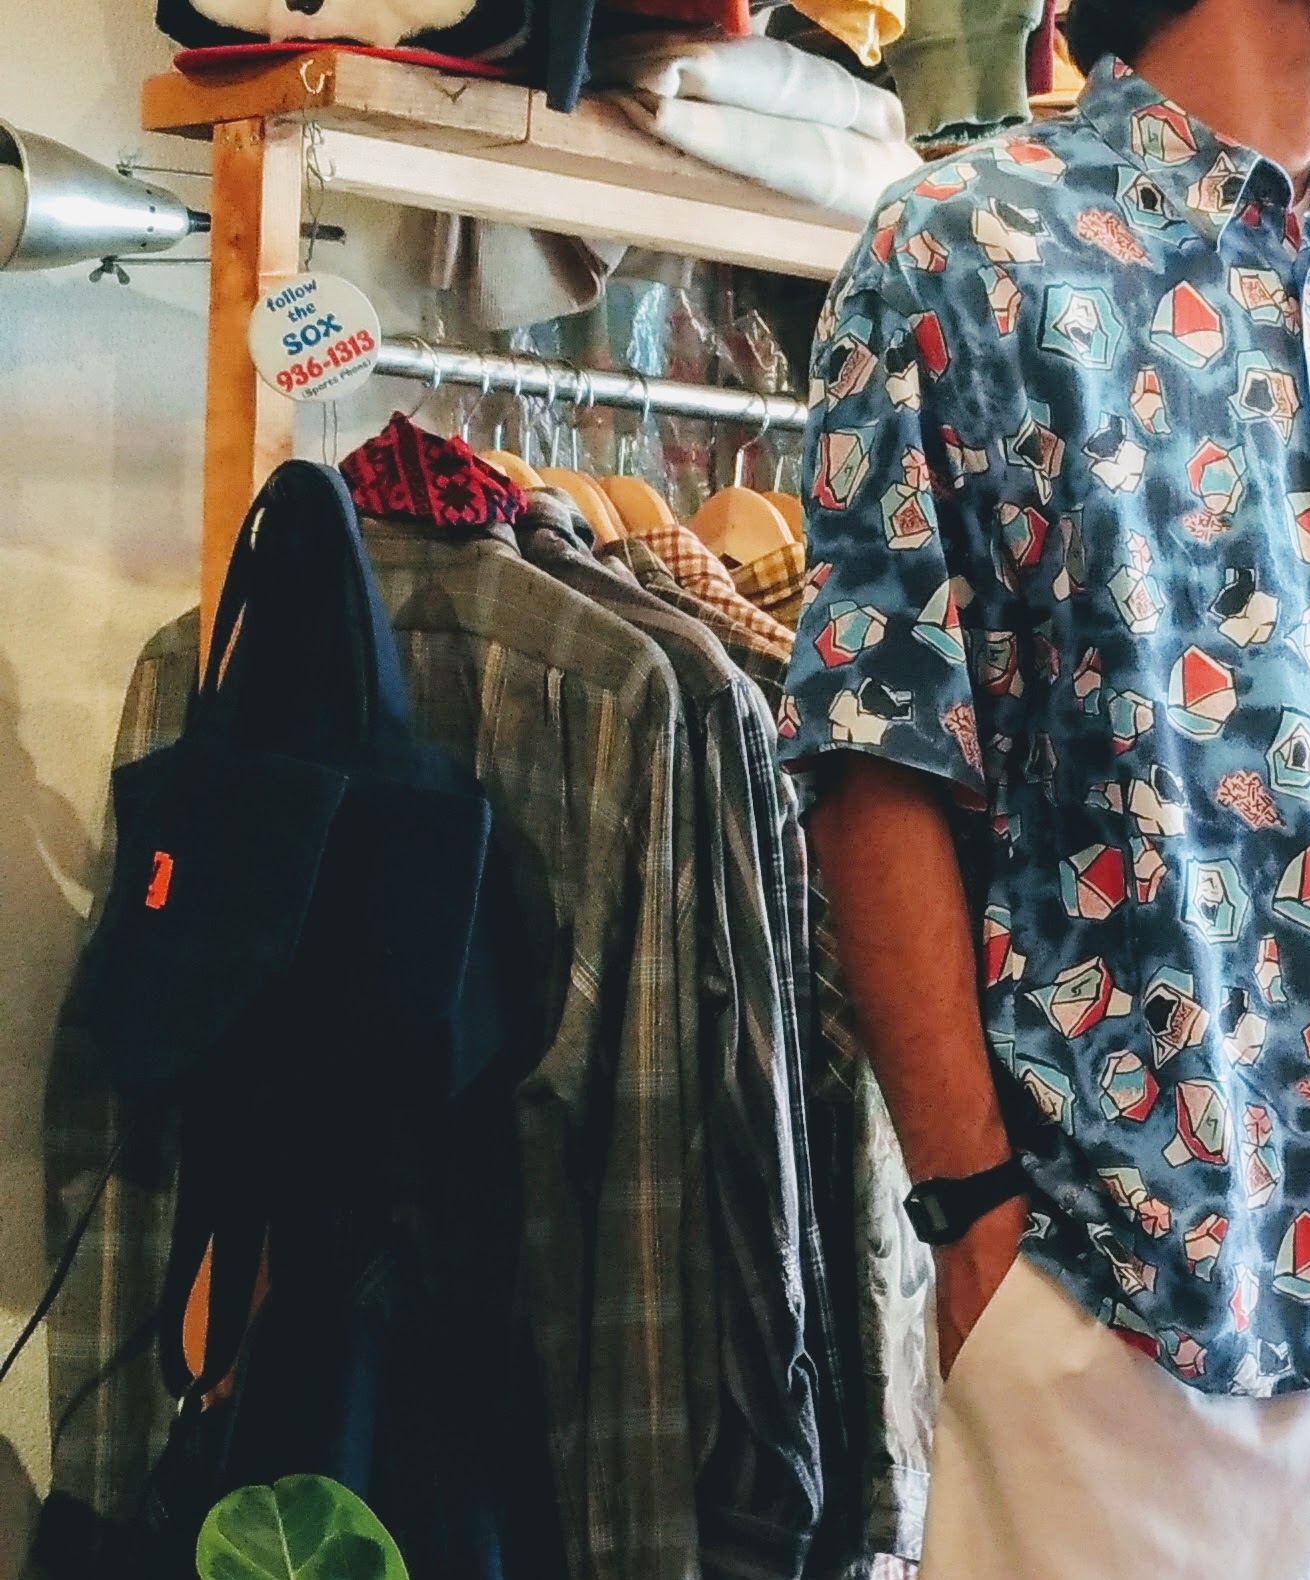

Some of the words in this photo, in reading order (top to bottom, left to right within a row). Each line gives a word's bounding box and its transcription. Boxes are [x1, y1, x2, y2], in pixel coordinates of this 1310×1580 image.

[266, 279, 317, 312] follow
[287, 302, 316, 322] the
[282, 313, 343, 356] SOX
[276, 329, 375, 392] 936-1313
